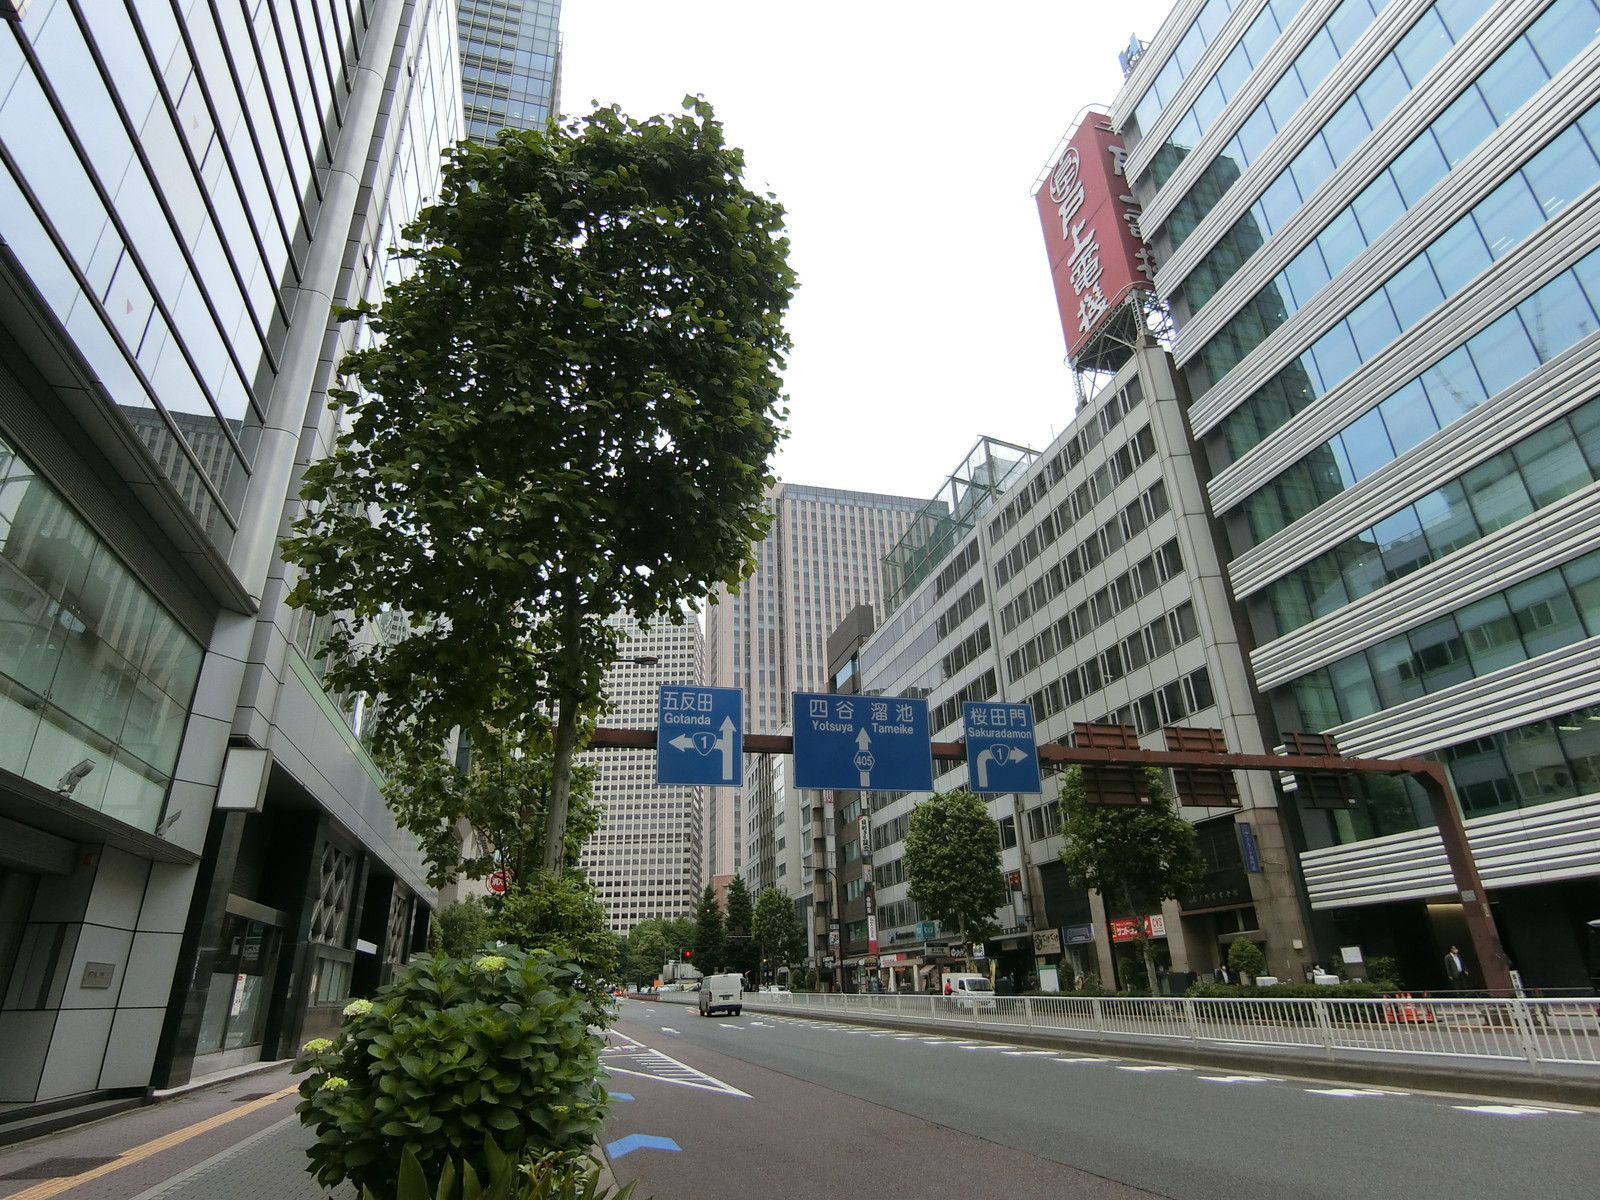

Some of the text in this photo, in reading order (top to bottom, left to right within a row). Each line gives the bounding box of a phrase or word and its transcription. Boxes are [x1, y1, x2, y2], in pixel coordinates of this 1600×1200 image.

[1058, 181, 1111, 333] 戸上電機
[662, 691, 713, 711] 五反田
[809, 699, 914, 722] 四谷 溜池
[970, 707, 1026, 727] 桜田門
[664, 712, 711, 725] Gotanda
[812, 720, 914, 735] Yotsuya Tameike
[968, 726, 1032, 739] Sakuradamon
[700, 735, 707, 749] 1
[996, 747, 1002, 760] 1
[856, 756, 872, 766] 405
